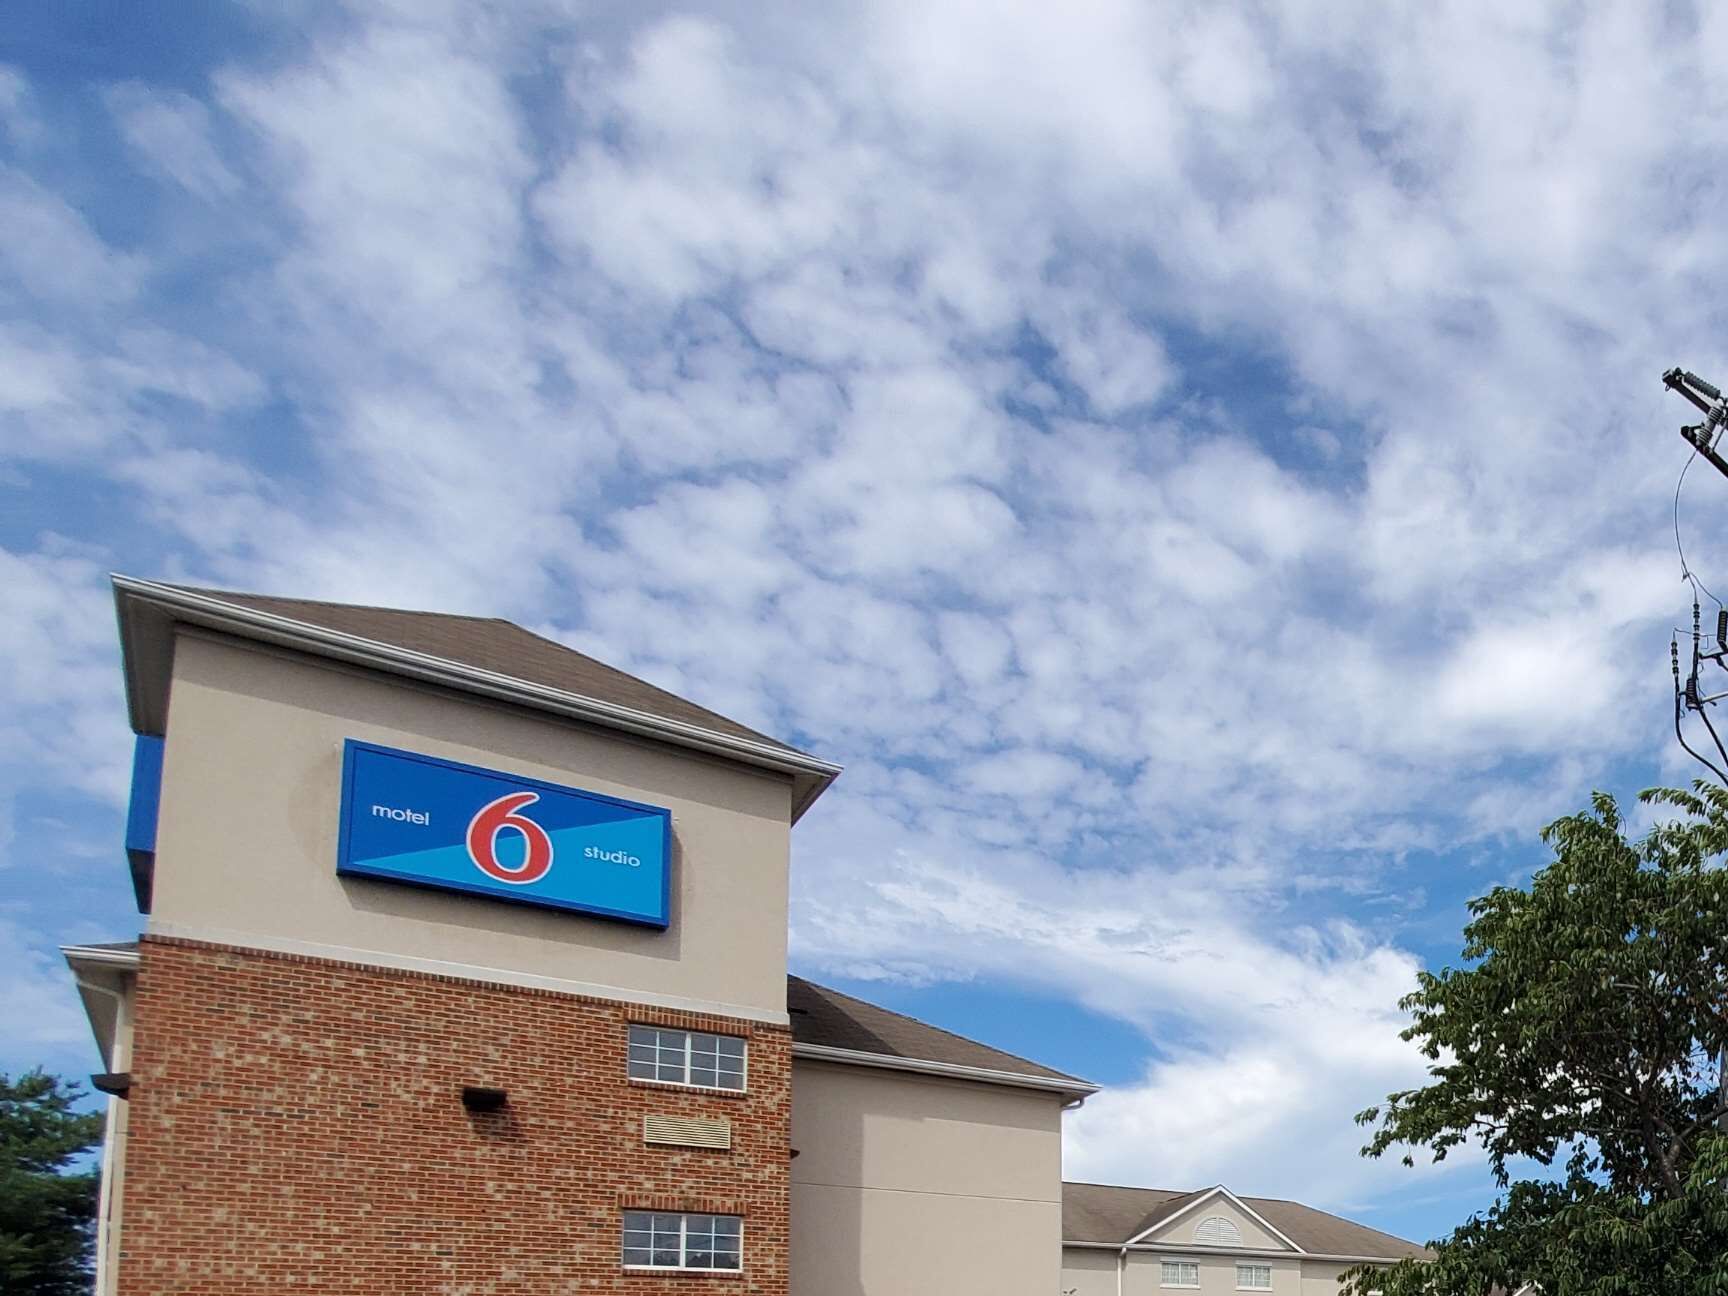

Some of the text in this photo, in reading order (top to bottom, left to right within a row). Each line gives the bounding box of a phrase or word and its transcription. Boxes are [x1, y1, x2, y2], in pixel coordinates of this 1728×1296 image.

[373, 791, 640, 884] motel 6 studio
